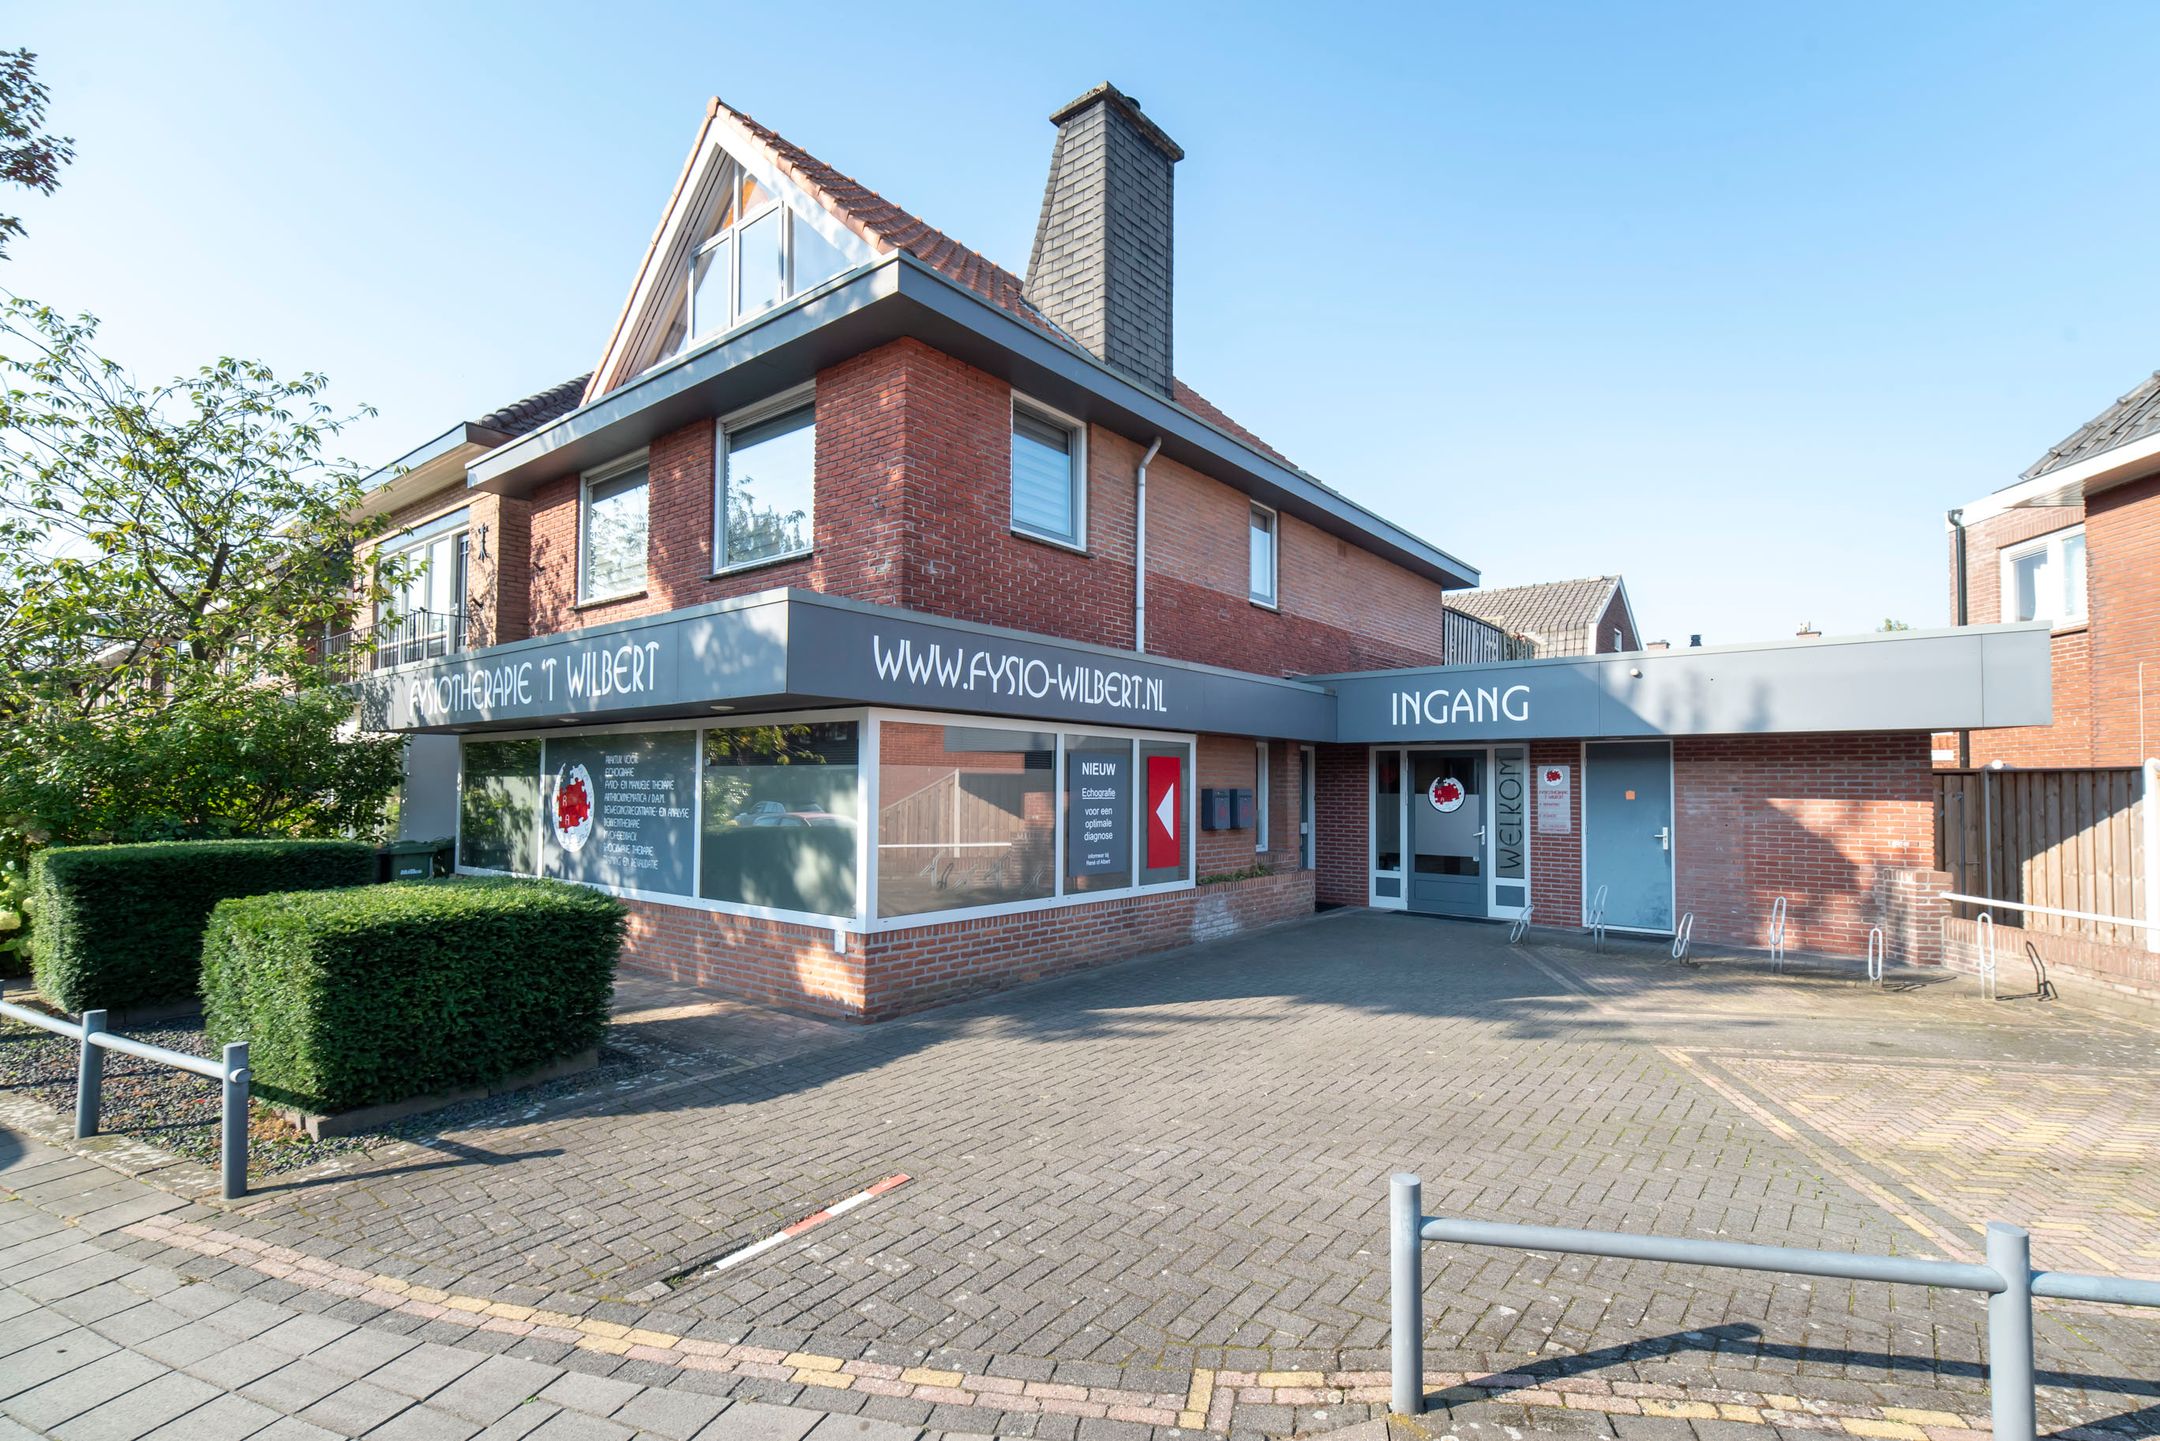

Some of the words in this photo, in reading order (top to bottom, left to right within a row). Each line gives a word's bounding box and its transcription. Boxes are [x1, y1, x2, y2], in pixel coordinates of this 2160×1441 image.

[409, 661, 533, 716] FYSIOTHERAPIE
[567, 641, 660, 698] WILBERT
[873, 635, 1167, 712] WWW.FYSIO-WILBERT.NL
[1392, 685, 1530, 725] INGANG
[1081, 762, 1116, 776] NIEUW
[1081, 787, 1116, 800] Echografie
[1085, 808, 1099, 816] voor
[1100, 807, 1113, 816] een
[1499, 757, 1522, 869] WELKOM
[1084, 819, 1113, 830] optimale
[1083, 832, 1113, 842] diagnose
